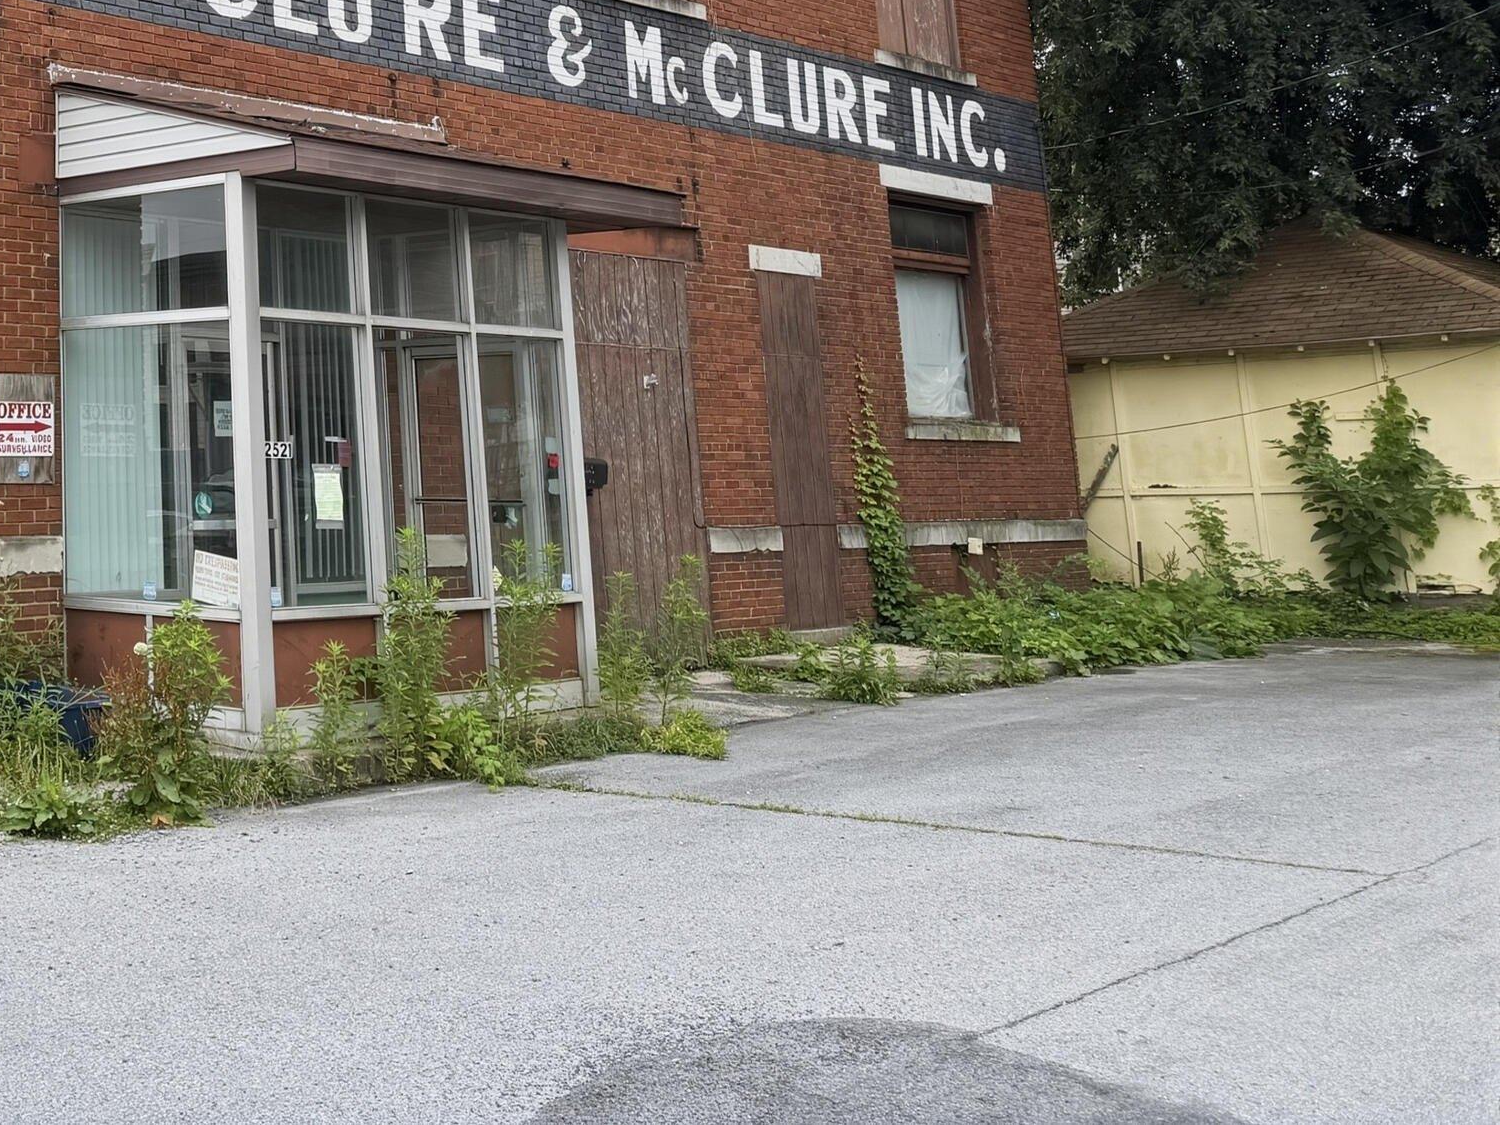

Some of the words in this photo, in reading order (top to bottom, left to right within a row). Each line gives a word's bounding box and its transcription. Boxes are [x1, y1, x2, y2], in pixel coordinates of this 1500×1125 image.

[547, 4, 593, 87] &
[911, 86, 1007, 173] INC.
[265, 442, 292, 458] 2521
